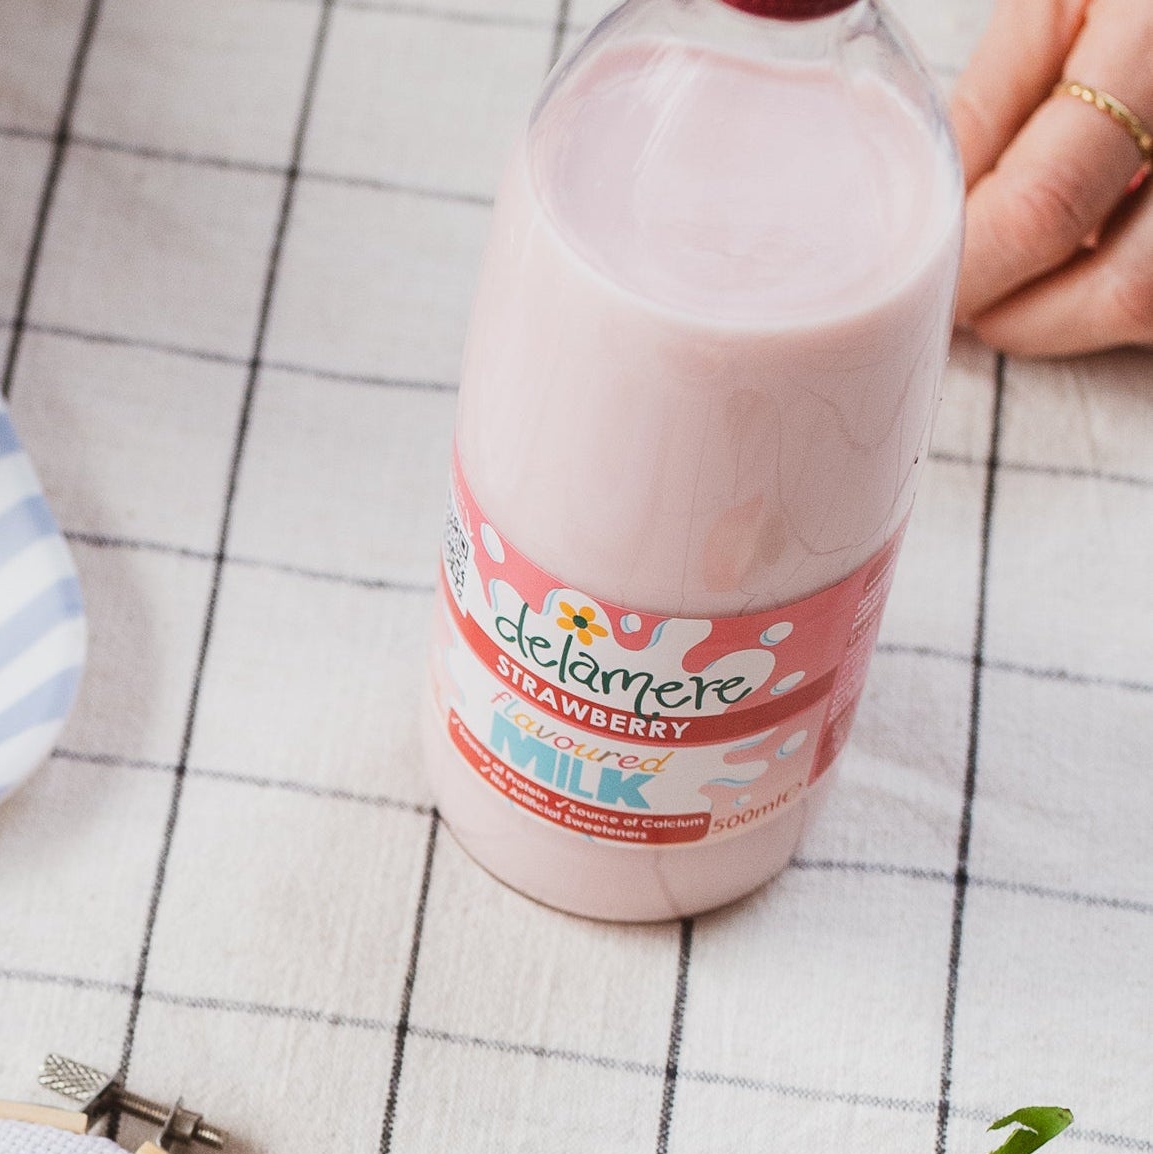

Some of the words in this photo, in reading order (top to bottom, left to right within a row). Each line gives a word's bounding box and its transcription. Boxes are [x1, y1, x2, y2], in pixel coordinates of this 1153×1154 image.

[496, 602, 752, 723] delamere
[496, 654, 692, 740] STRAWBERRY
[489, 710, 657, 810] MILK
[491, 692, 675, 773] flavoured
[490, 772, 507, 790] No
[509, 787, 561, 820] Artificial
[564, 814, 647, 840] Sweeteners
[506, 770, 549, 802] Protein
[569, 803, 618, 825] Source
[623, 817, 638, 828] of
[642, 817, 705, 829] Calcium
